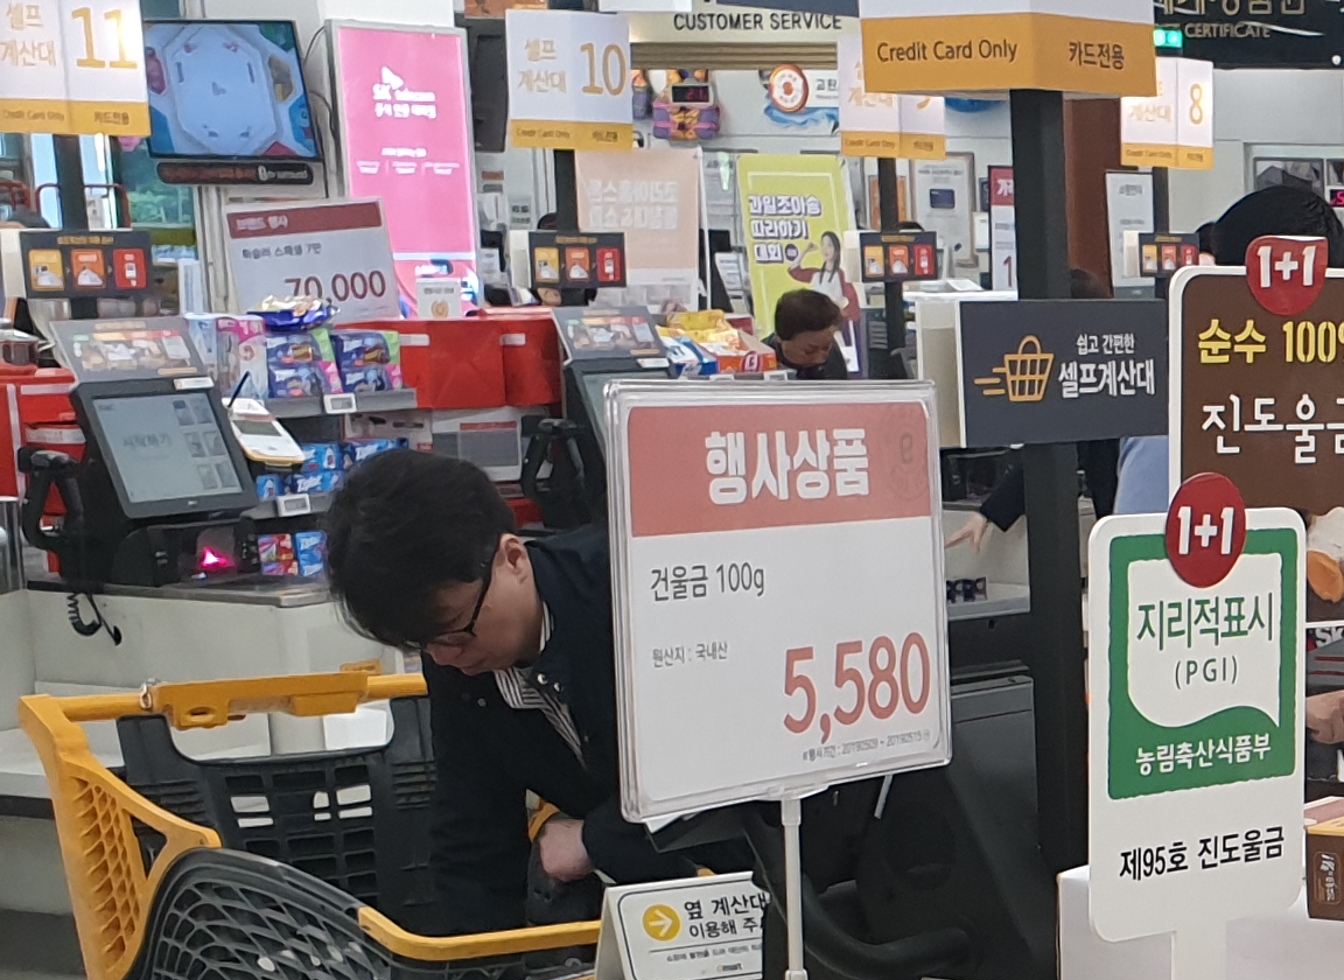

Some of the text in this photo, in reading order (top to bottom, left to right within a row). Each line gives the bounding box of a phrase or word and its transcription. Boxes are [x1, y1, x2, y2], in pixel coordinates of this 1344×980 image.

[71, 7, 138, 69] 11
[674, 12, 842, 31] CUSTOMER SERVICE
[1184, 22, 1270, 39] CERTIFICATE
[580, 42, 627, 96] 10
[877, 39, 1018, 63] Credit Card Only
[1069, 41, 1125, 70] 카드전용
[517, 70, 568, 94] 계산대
[1190, 83, 1204, 125] 8
[1257, 245, 1316, 289] 1+1
[1075, 332, 1136, 356] 쉽고 간편한
[1198, 318, 1268, 364] 순수
[1058, 357, 1157, 399] 셀프계산대
[705, 428, 870, 505] 행사상품
[1177, 505, 1236, 556] 1+1
[650, 562, 765, 603] 건울금 100g
[1137, 592, 1275, 652] 지리적표시
[652, 641, 728, 668] 원산지 국내산
[1174, 655, 1239, 690] (PGI)
[784, 631, 931, 745] 5,580
[1136, 733, 1272, 776] 농림축산식품부
[1120, 827, 1286, 881] 제95호 진도울금
[684, 893, 766, 921] 옆 계산대
[689, 917, 764, 939] 이용해 주
